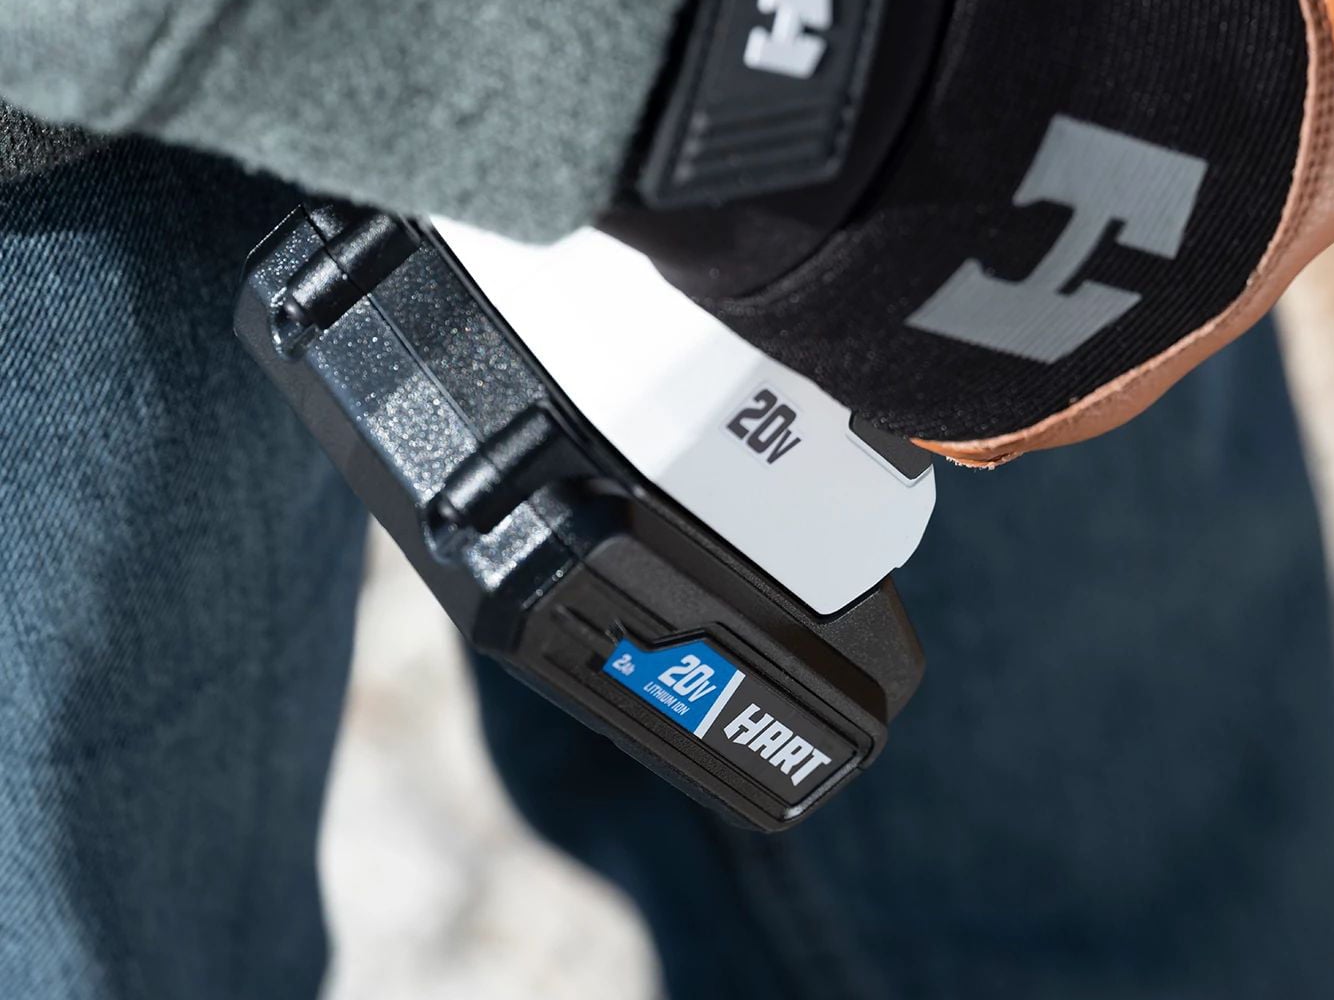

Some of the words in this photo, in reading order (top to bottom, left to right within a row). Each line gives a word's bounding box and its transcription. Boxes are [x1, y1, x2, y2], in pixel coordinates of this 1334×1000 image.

[643, 681, 678, 707] LITHIUM
[670, 700, 690, 716] ION
[723, 703, 832, 786] HART
